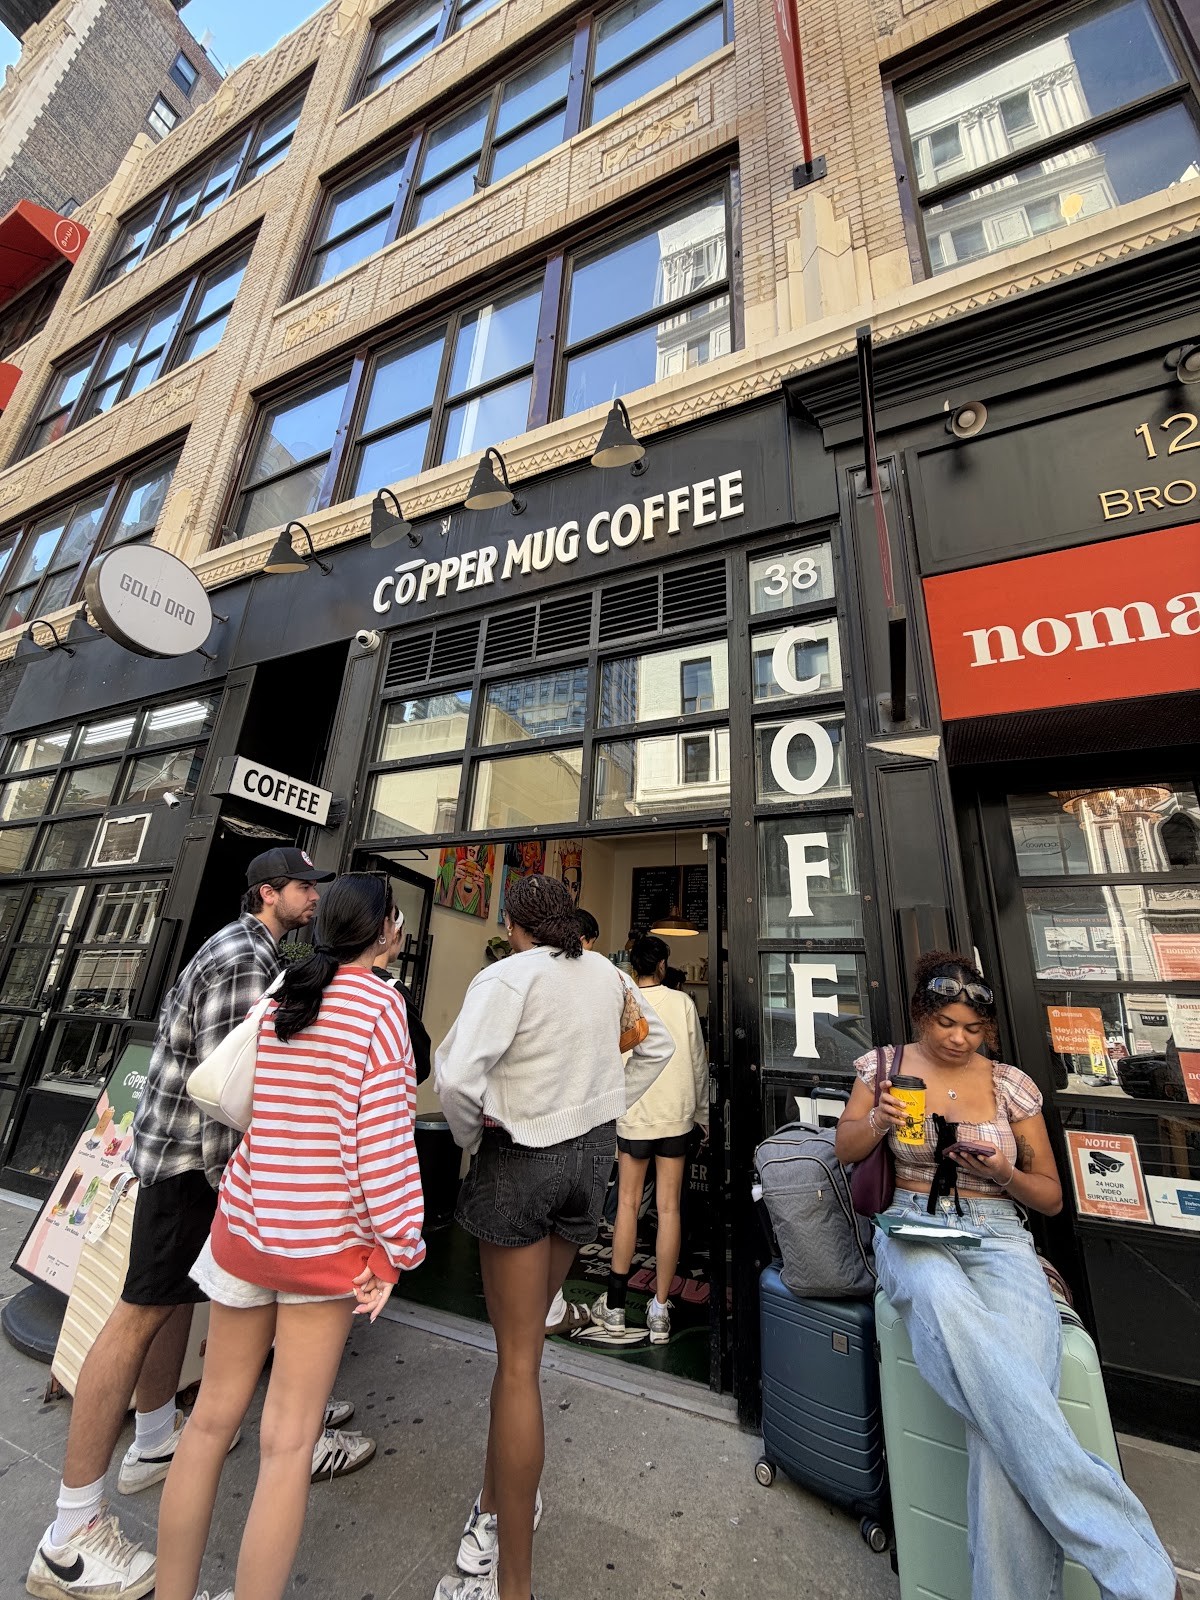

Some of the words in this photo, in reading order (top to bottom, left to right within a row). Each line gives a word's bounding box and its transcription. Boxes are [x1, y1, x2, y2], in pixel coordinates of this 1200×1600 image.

[1099, 480, 1198, 520] BRO
[373, 545, 498, 614] COPPER
[501, 520, 580, 580] MUG
[585, 470, 746, 555] COFFEE
[763, 557, 818, 596] 38
[119, 573, 163, 608] GOLD
[164, 597, 196, 626] ORO
[243, 769, 321, 816] COFFEE
[1085, 1138, 1121, 1149] NOTICE
[1087, 1193, 1138, 1204] SURVEILLANCE
[1104, 1181, 1125, 1189] HOUR
